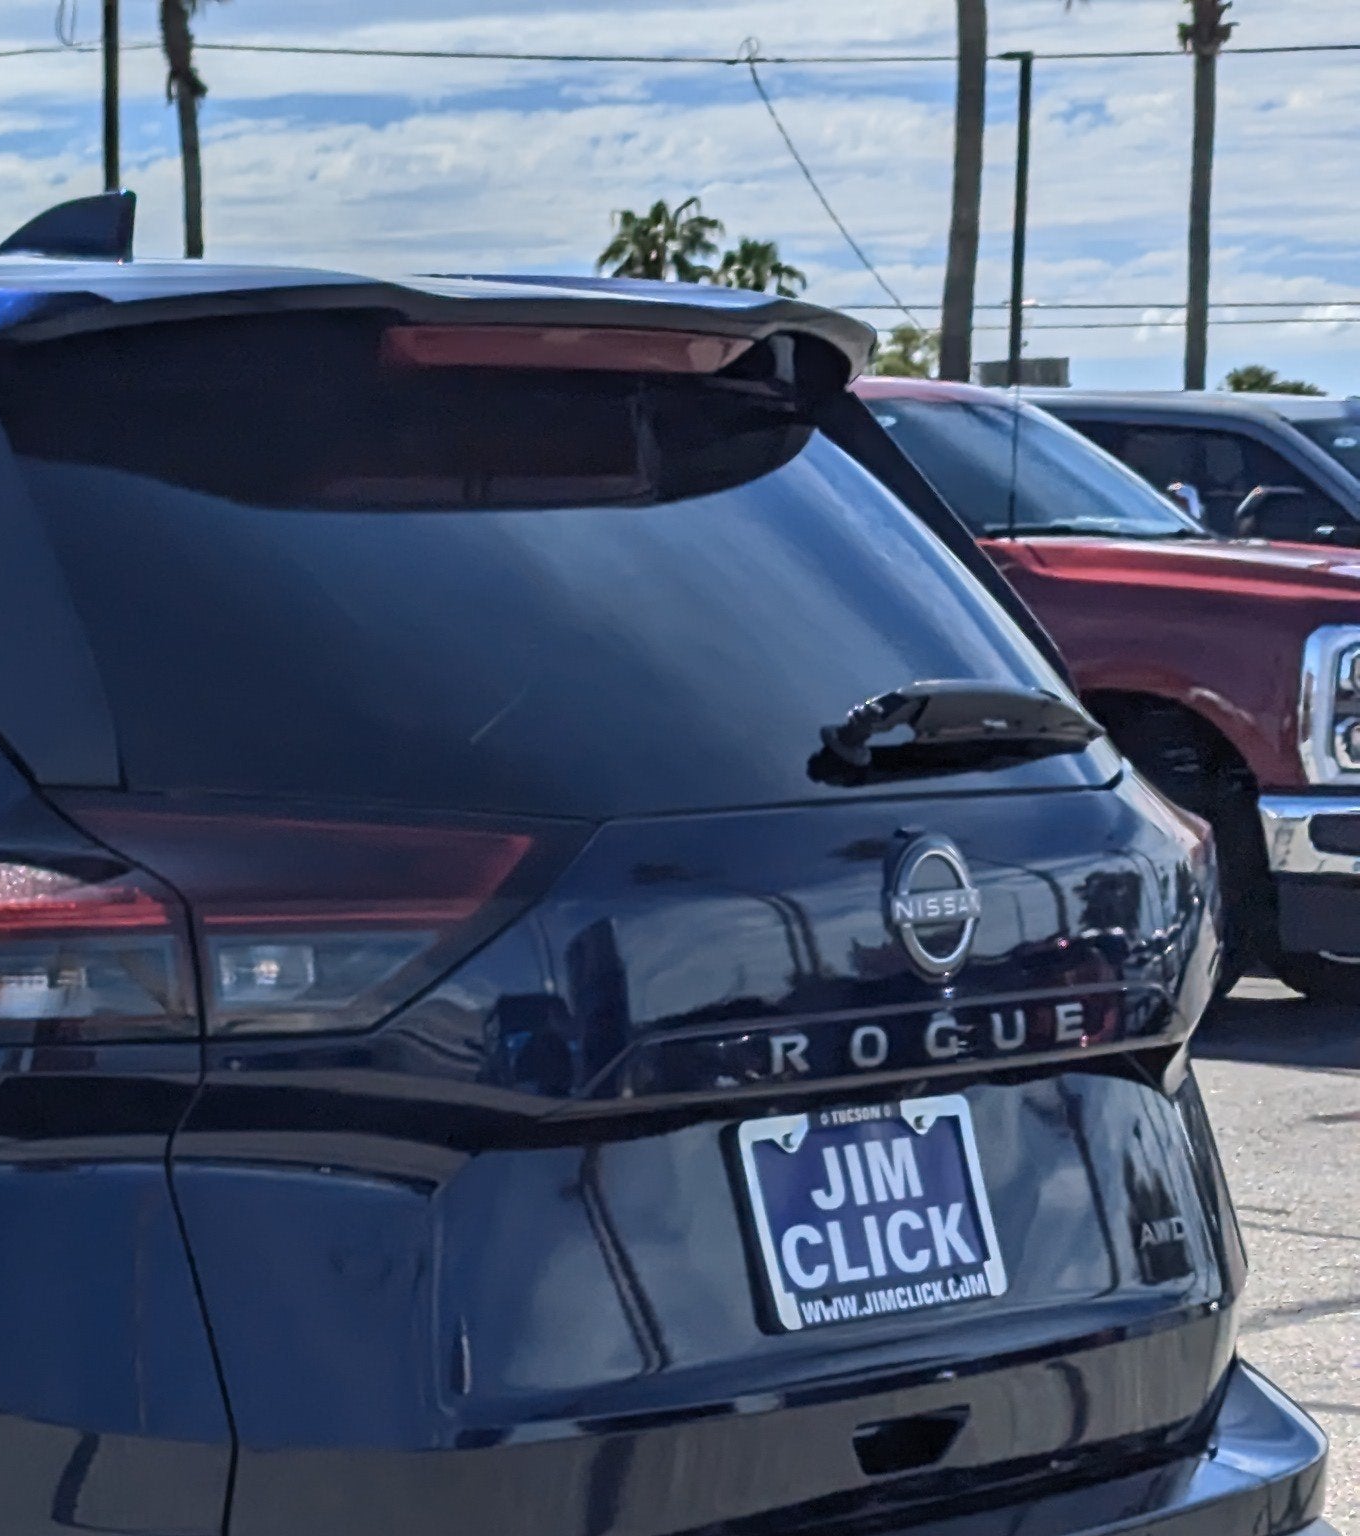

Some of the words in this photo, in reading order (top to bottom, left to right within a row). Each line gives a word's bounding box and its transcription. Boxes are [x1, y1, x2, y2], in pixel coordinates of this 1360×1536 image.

[769, 1002, 1085, 1074] ROGUE
[831, 1105, 881, 1125] TUCSON
[810, 1137, 923, 1211] JIM
[781, 1202, 978, 1290] CLICK
[1140, 1217, 1186, 1249] AWD
[800, 1272, 988, 1324] WWW.JIMCLICK.COM
